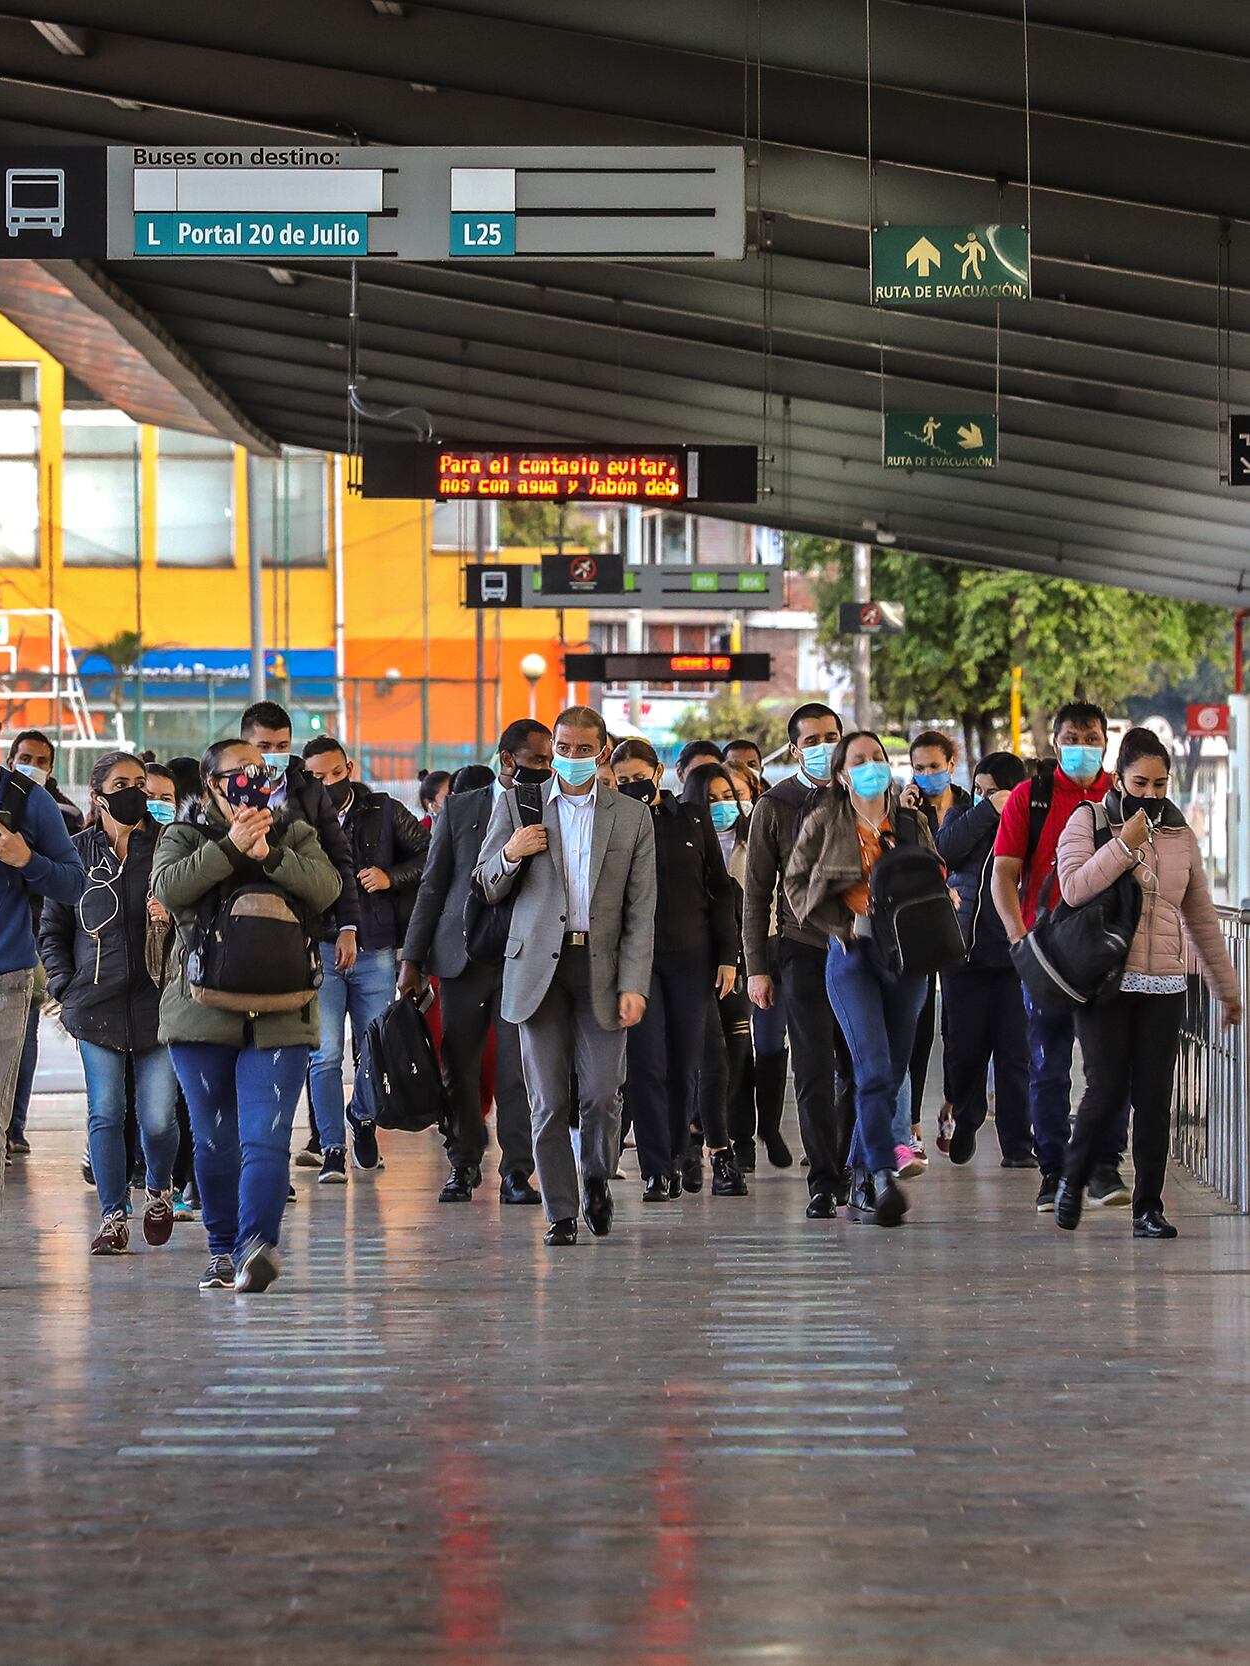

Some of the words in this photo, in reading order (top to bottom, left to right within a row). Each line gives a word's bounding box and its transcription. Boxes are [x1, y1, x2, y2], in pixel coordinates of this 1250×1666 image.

[133, 148, 196, 165] Buses
[203, 152, 243, 165] con
[250, 148, 340, 165] destino:
[148, 223, 161, 245] L
[178, 222, 242, 245] Portal
[248, 224, 274, 245] 20
[279, 223, 305, 245] de
[310, 223, 360, 246] Julio
[464, 223, 502, 246] L25
[876, 286, 911, 299] RUTA
[915, 286, 931, 298] DE
[936, 281, 1022, 298] EVACUACIÓN
[440, 456, 480, 474] Para
[490, 456, 509, 474] el
[519, 457, 599, 475] contagio
[887, 456, 912, 466] RUTA
[915, 457, 926, 466] DE
[930, 455, 992, 466] EVACUACIÓN
[440, 479, 470, 494] nos
[478, 480, 509, 494] con
[518, 480, 558, 495] agua
[568, 480, 578, 494] y
[589, 477, 637, 496] jabón
